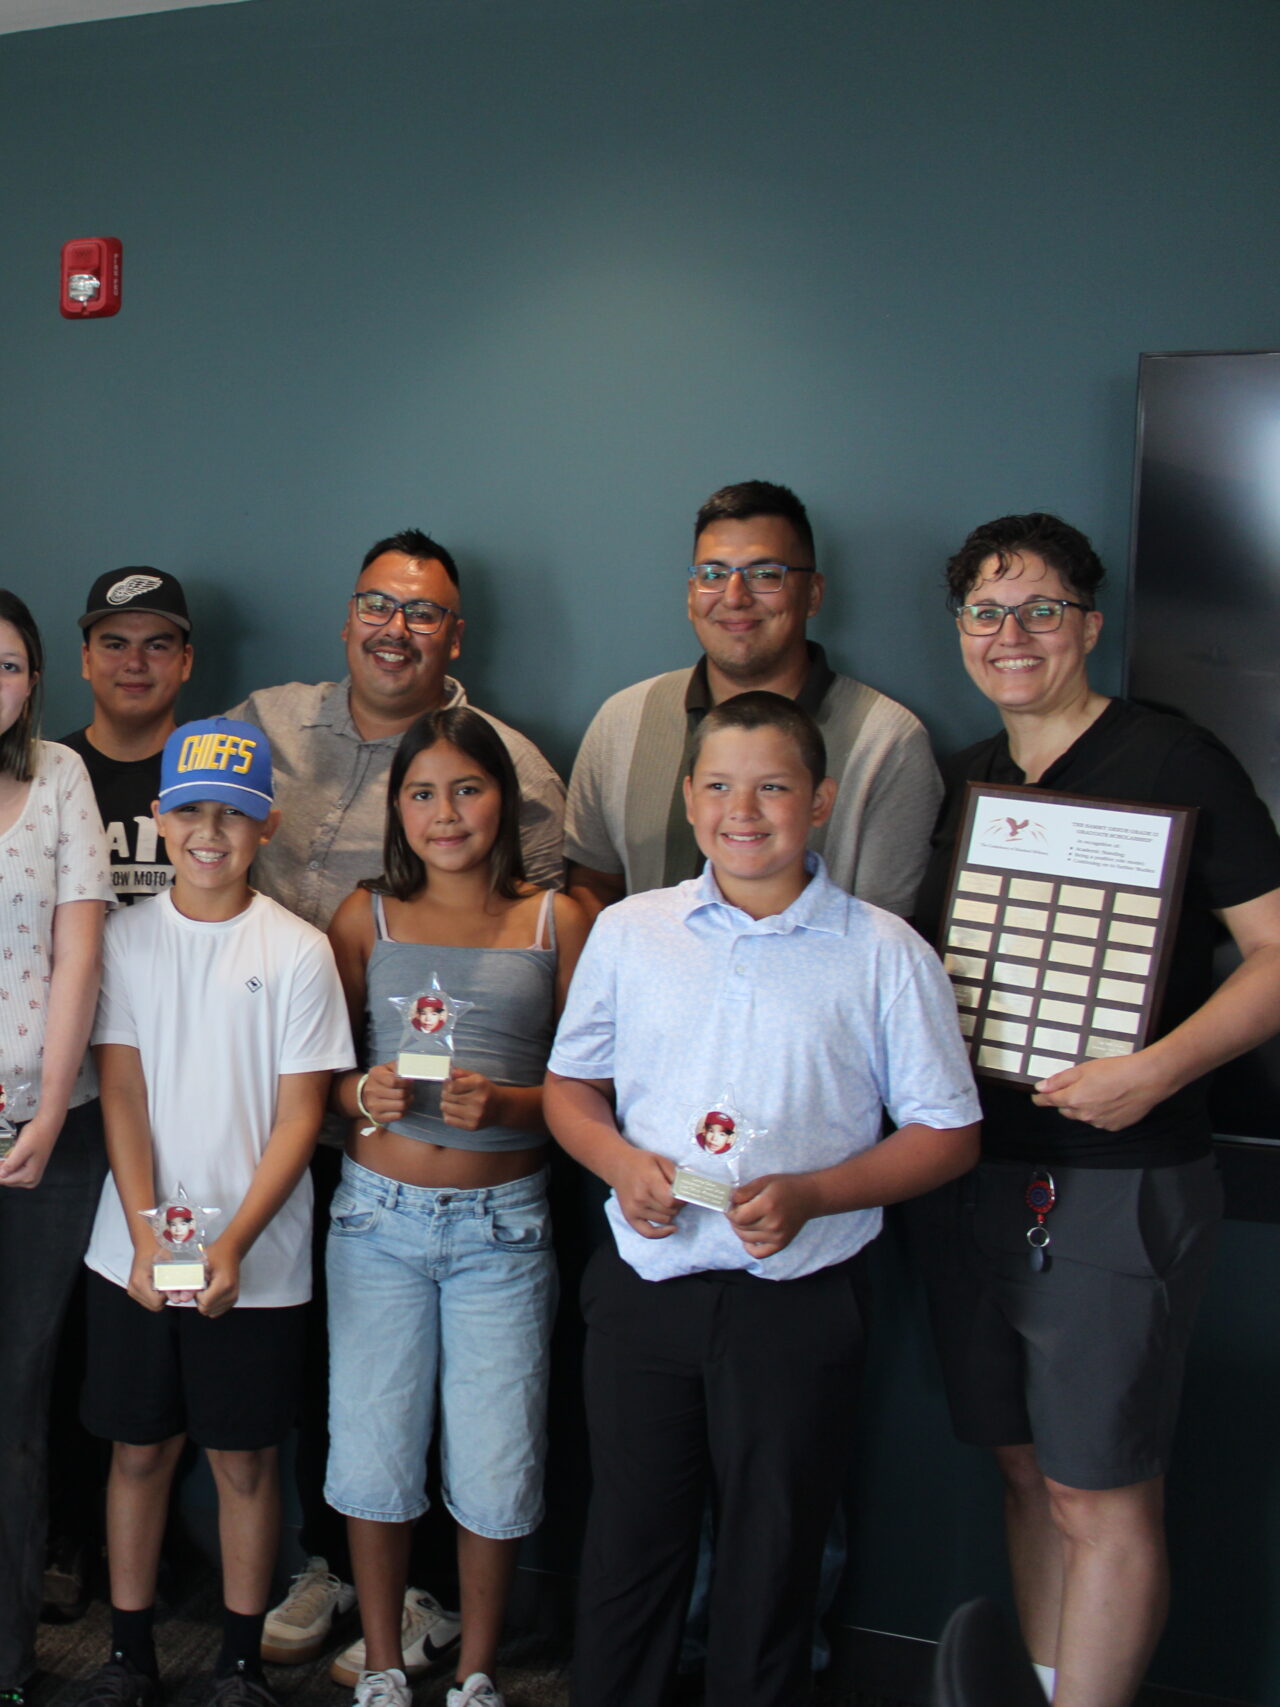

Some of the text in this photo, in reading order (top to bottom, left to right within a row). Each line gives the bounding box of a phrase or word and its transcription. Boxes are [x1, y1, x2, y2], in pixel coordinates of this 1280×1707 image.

[177, 733, 257, 775] CHIEFS
[111, 871, 167, 887] OW MOTO
